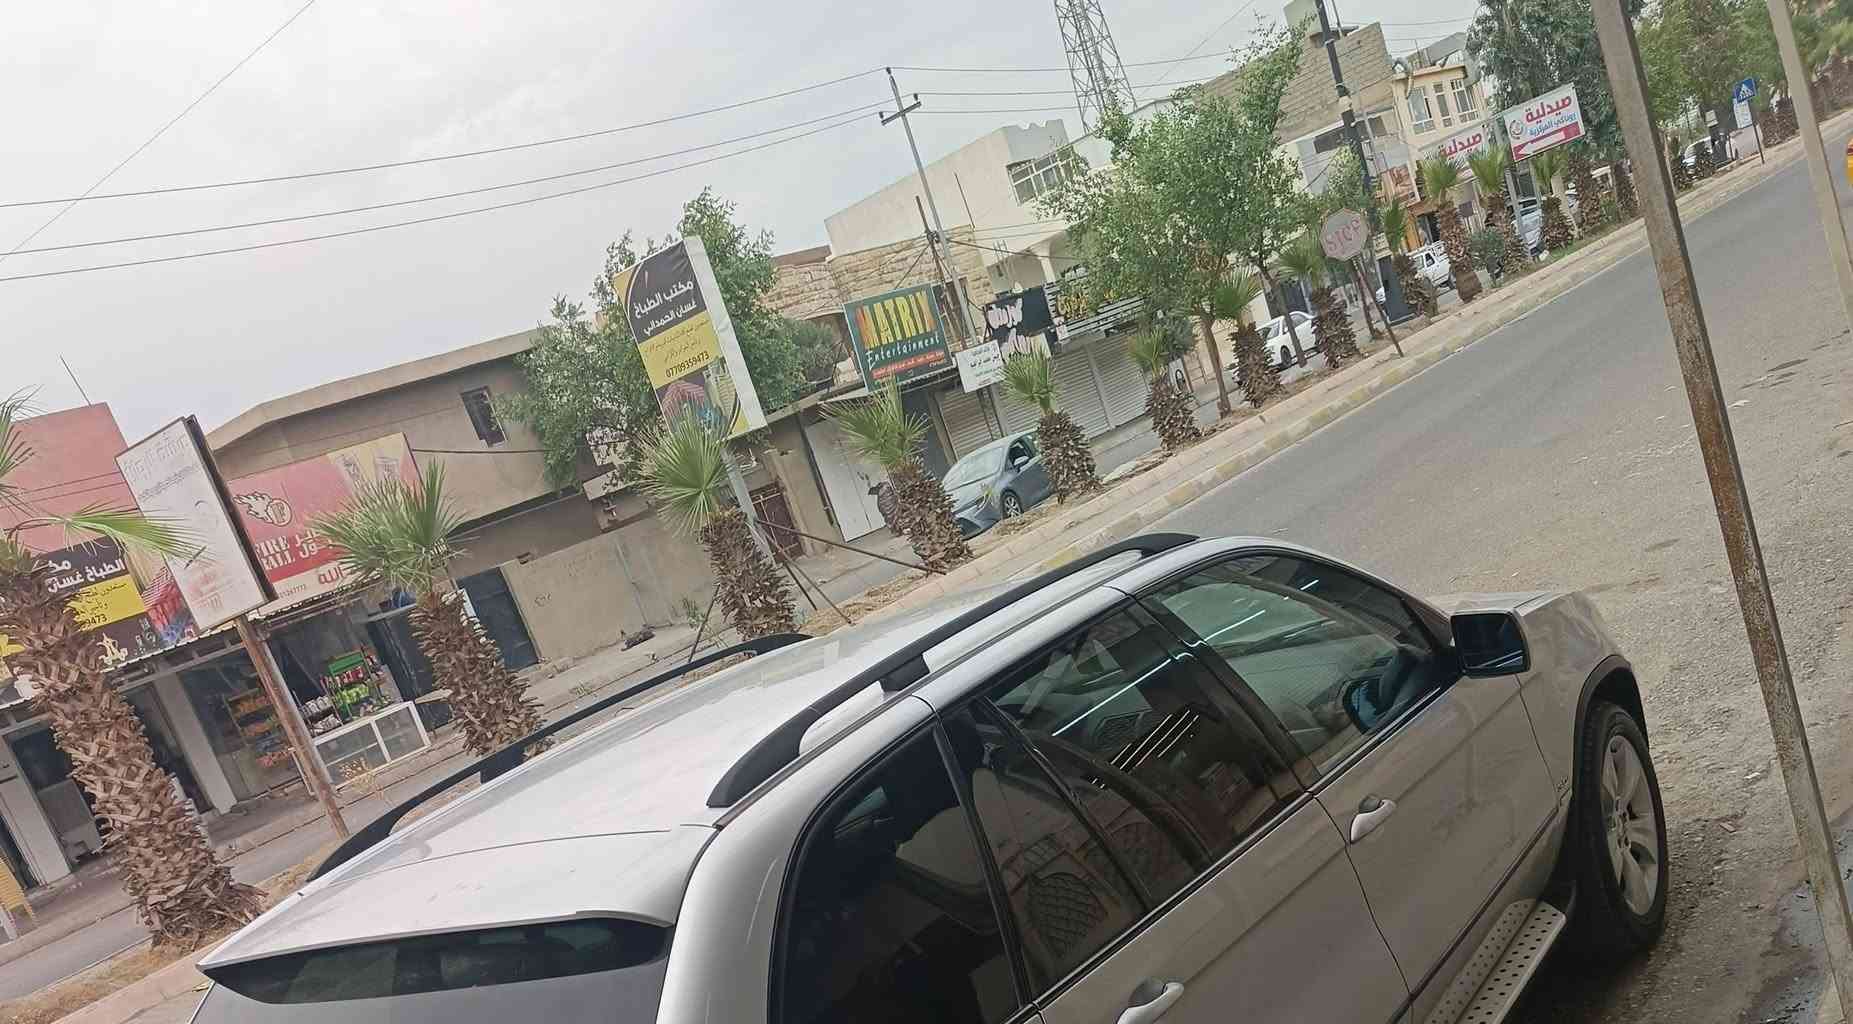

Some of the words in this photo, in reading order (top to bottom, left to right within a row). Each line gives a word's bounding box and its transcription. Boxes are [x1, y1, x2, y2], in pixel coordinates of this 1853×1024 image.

[1525, 95, 1572, 123] صيدلية
[1439, 131, 1482, 160] صيدلية
[1326, 218, 1360, 252] STOP
[633, 291, 663, 319] الطباخ
[663, 280, 694, 302] مكتب
[676, 297, 697, 317] غسان
[856, 290, 935, 350] MATRIX
[643, 309, 675, 336] الحمداني
[865, 331, 940, 371] Entertainment
[85, 558, 126, 582] الطباخ
